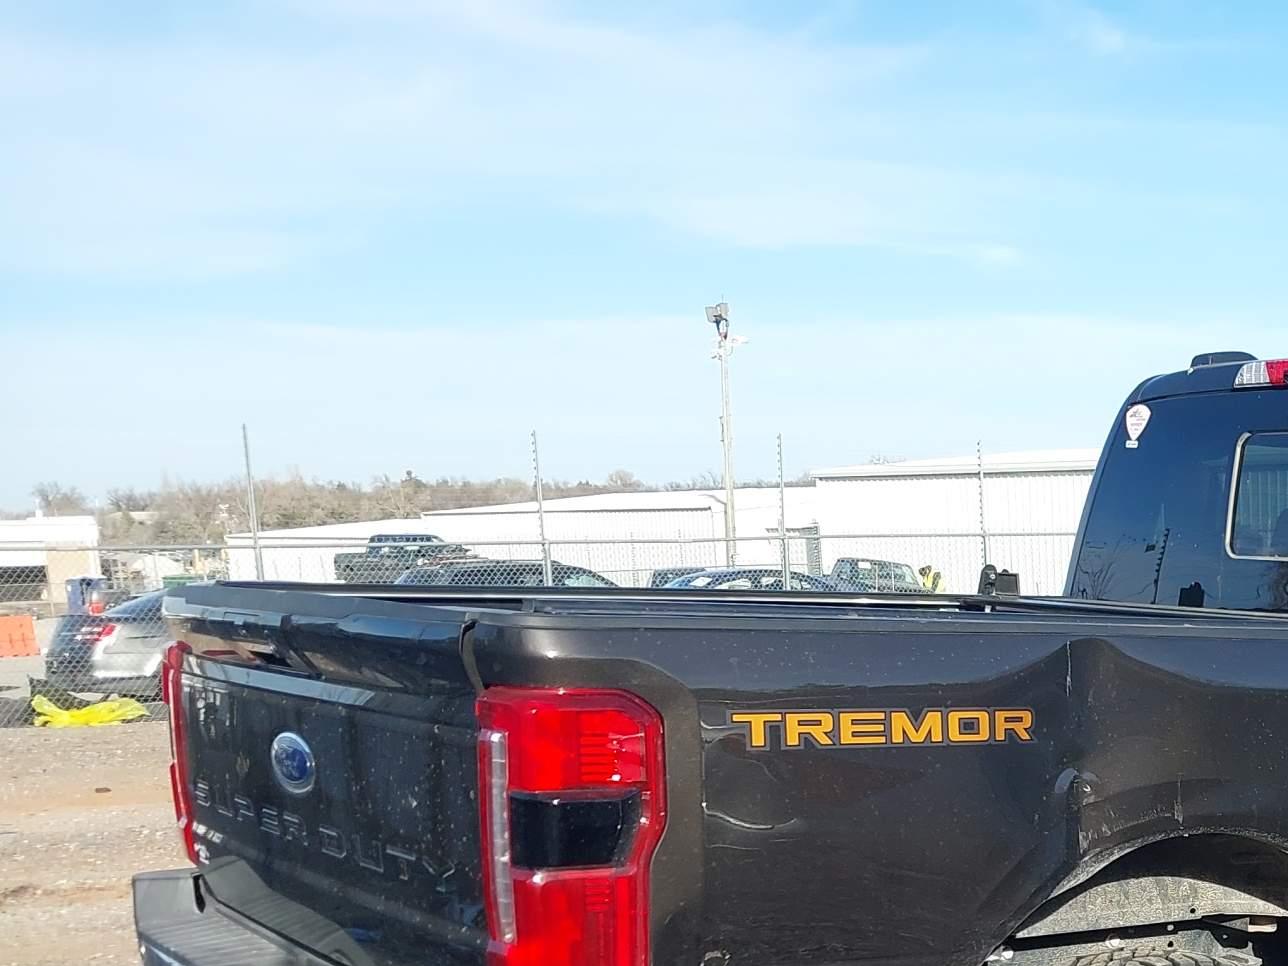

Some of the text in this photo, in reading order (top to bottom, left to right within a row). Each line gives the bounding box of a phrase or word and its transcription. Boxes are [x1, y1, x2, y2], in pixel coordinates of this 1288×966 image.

[730, 708, 1034, 747] TREMOR
[194, 780, 456, 881] SUPER DUTY
